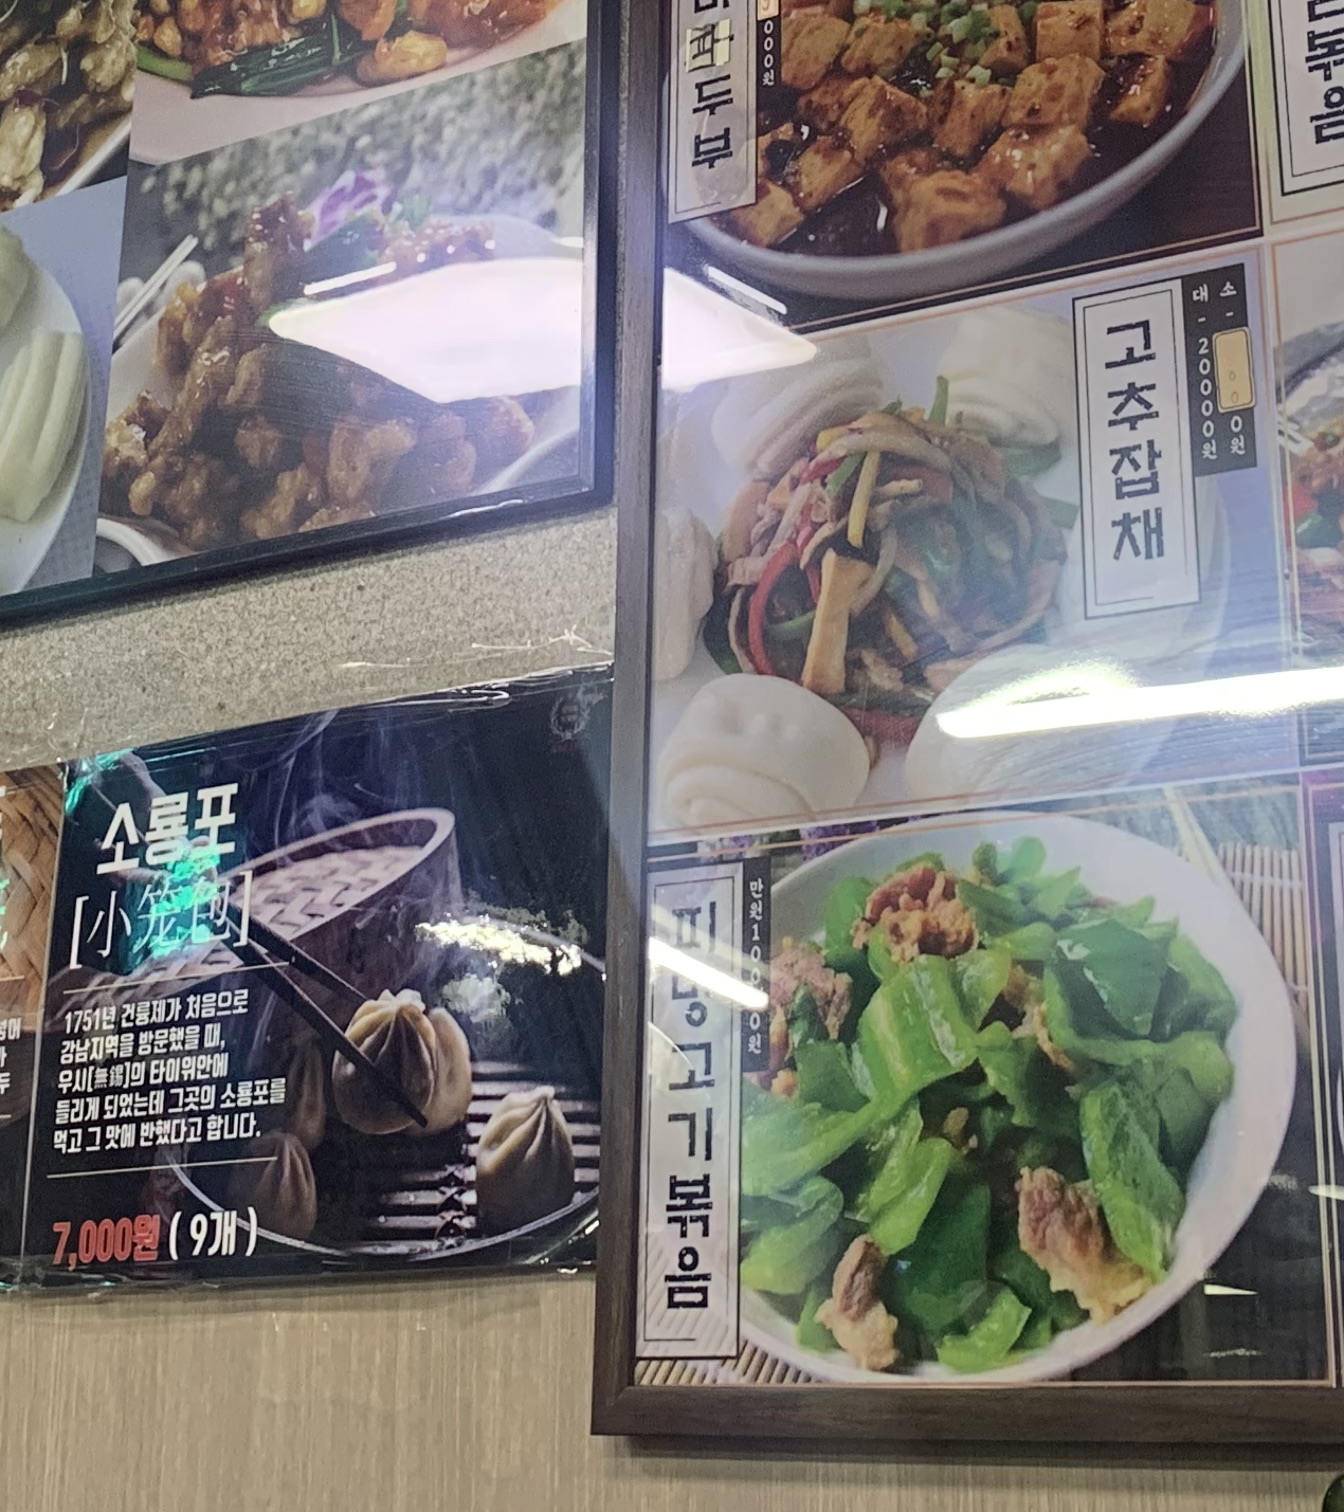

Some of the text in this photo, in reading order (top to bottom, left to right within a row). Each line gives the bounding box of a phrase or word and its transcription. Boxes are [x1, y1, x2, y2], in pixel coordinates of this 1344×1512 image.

[1105, 319, 1165, 561] 고추잡채
[96, 783, 239, 875] 소룡포
[64, 988, 249, 1034] 1751년 건륭제가 처음으로
[60, 1032, 135, 1065] 강남지역을
[137, 1024, 200, 1055] 방문했을
[55, 1077, 287, 1125] 들리게 되었는데 그곳의 소룡포를
[53, 1111, 261, 1154] 먹고 그 맛에 반했다고 합니다.
[52, 1214, 161, 1272] 7,000원
